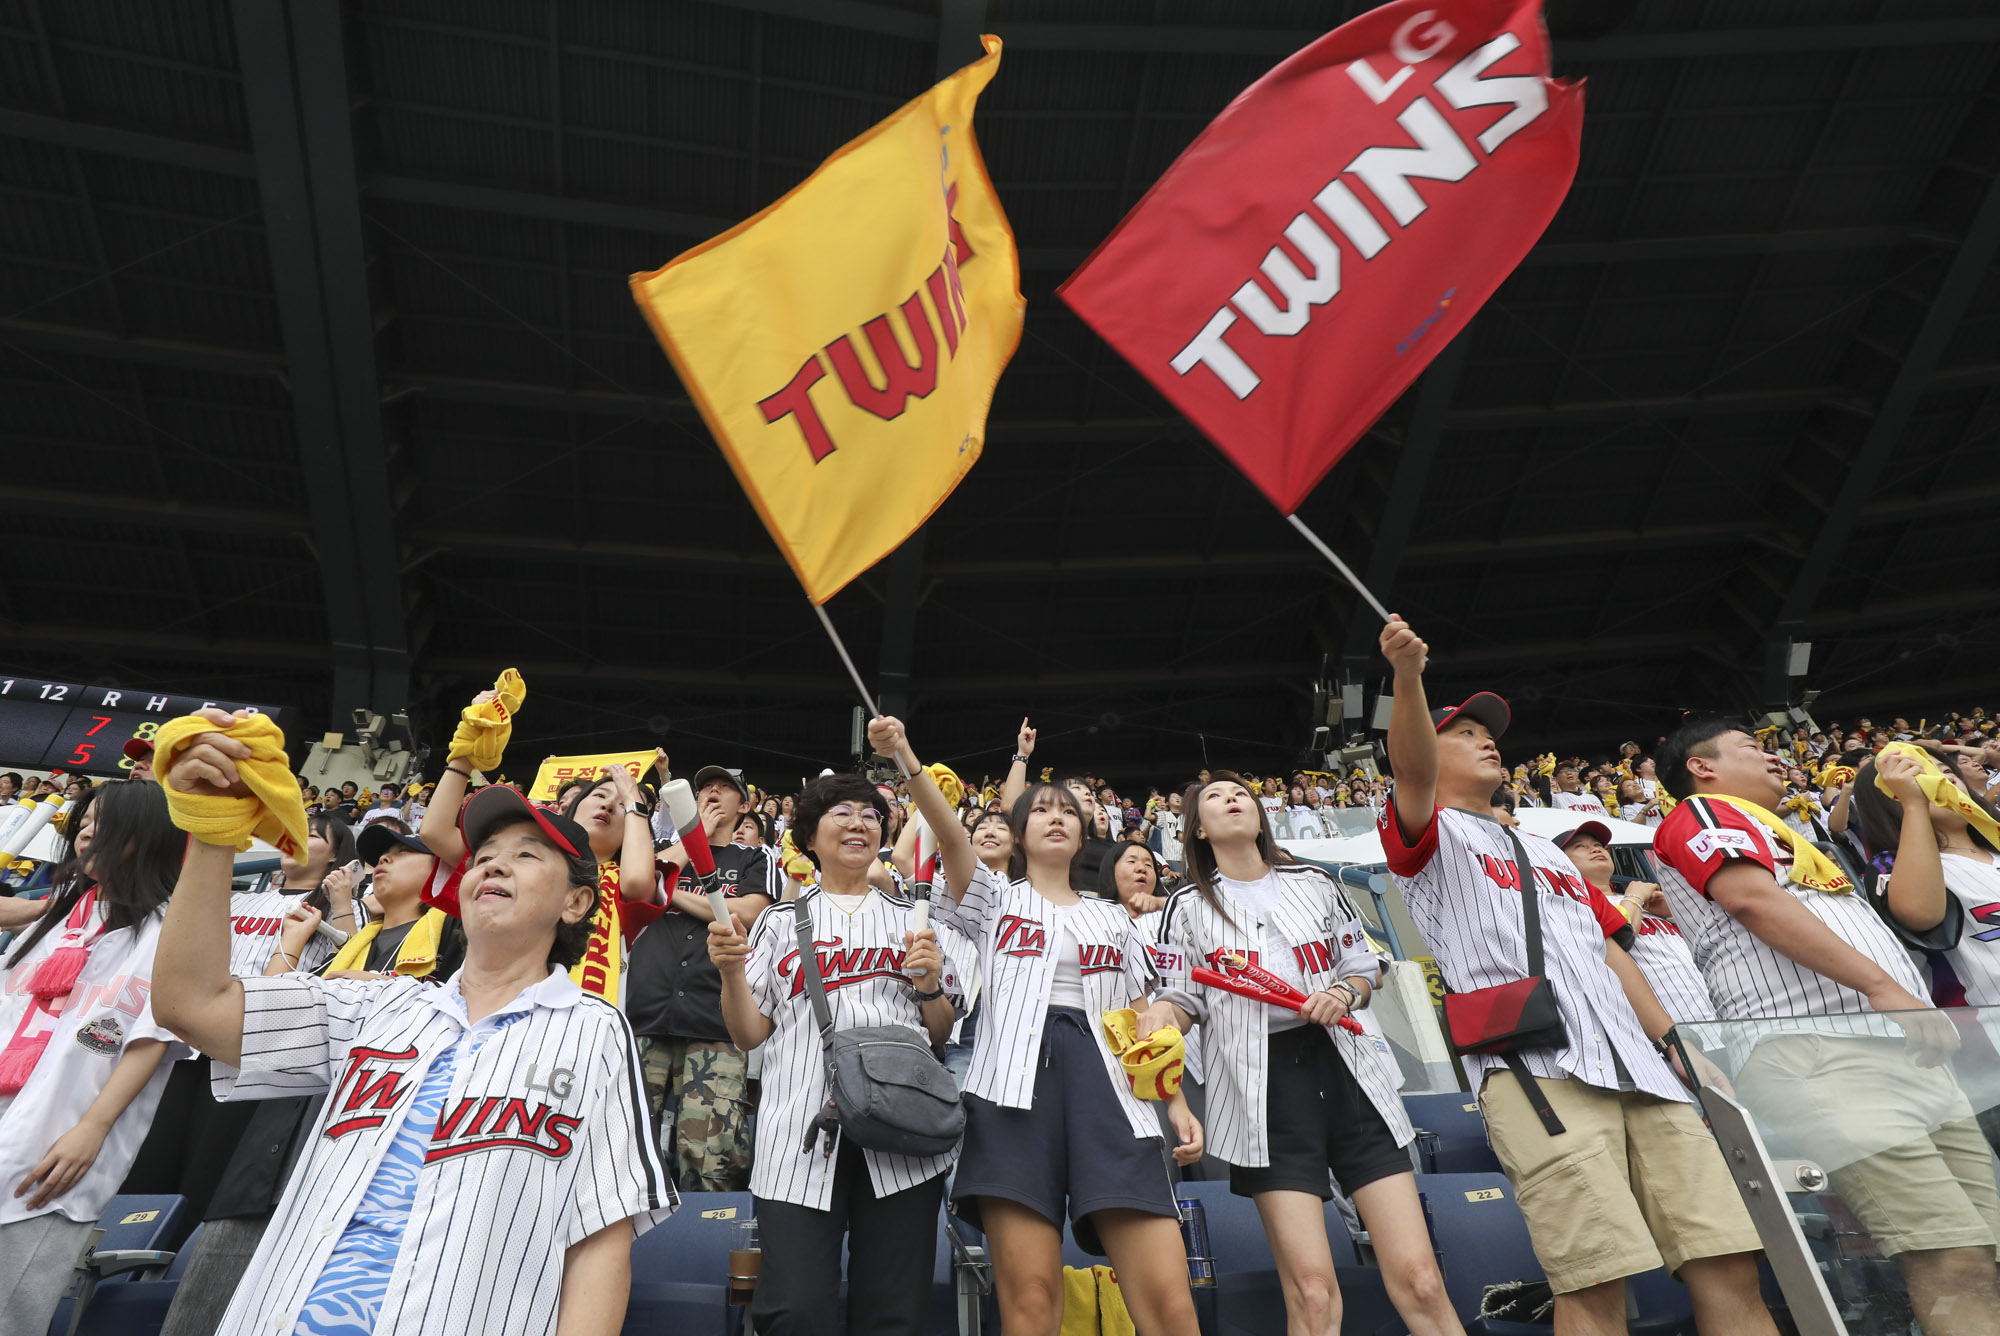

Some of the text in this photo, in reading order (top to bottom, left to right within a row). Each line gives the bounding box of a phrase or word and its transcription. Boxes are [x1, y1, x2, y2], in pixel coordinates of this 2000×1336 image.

[1345, 9, 1460, 105] LG
[1169, 31, 1550, 401] TWINS
[39, 684, 69, 701] 12
[101, 691, 122, 707] R
[145, 695, 168, 712] H
[86, 716, 112, 737] 7
[67, 743, 96, 765] 5
[716, 867, 738, 881] LG
[1802, 874, 1820, 888] LG
[1313, 916, 1333, 934] LG
[1353, 930, 1365, 943] LG
[777, 935, 914, 1001] TWIN
[524, 1063, 577, 1101] LG
[1476, 1190, 1494, 1200] 22
[132, 1212, 149, 1222] 29
[711, 1210, 727, 1220] 26
